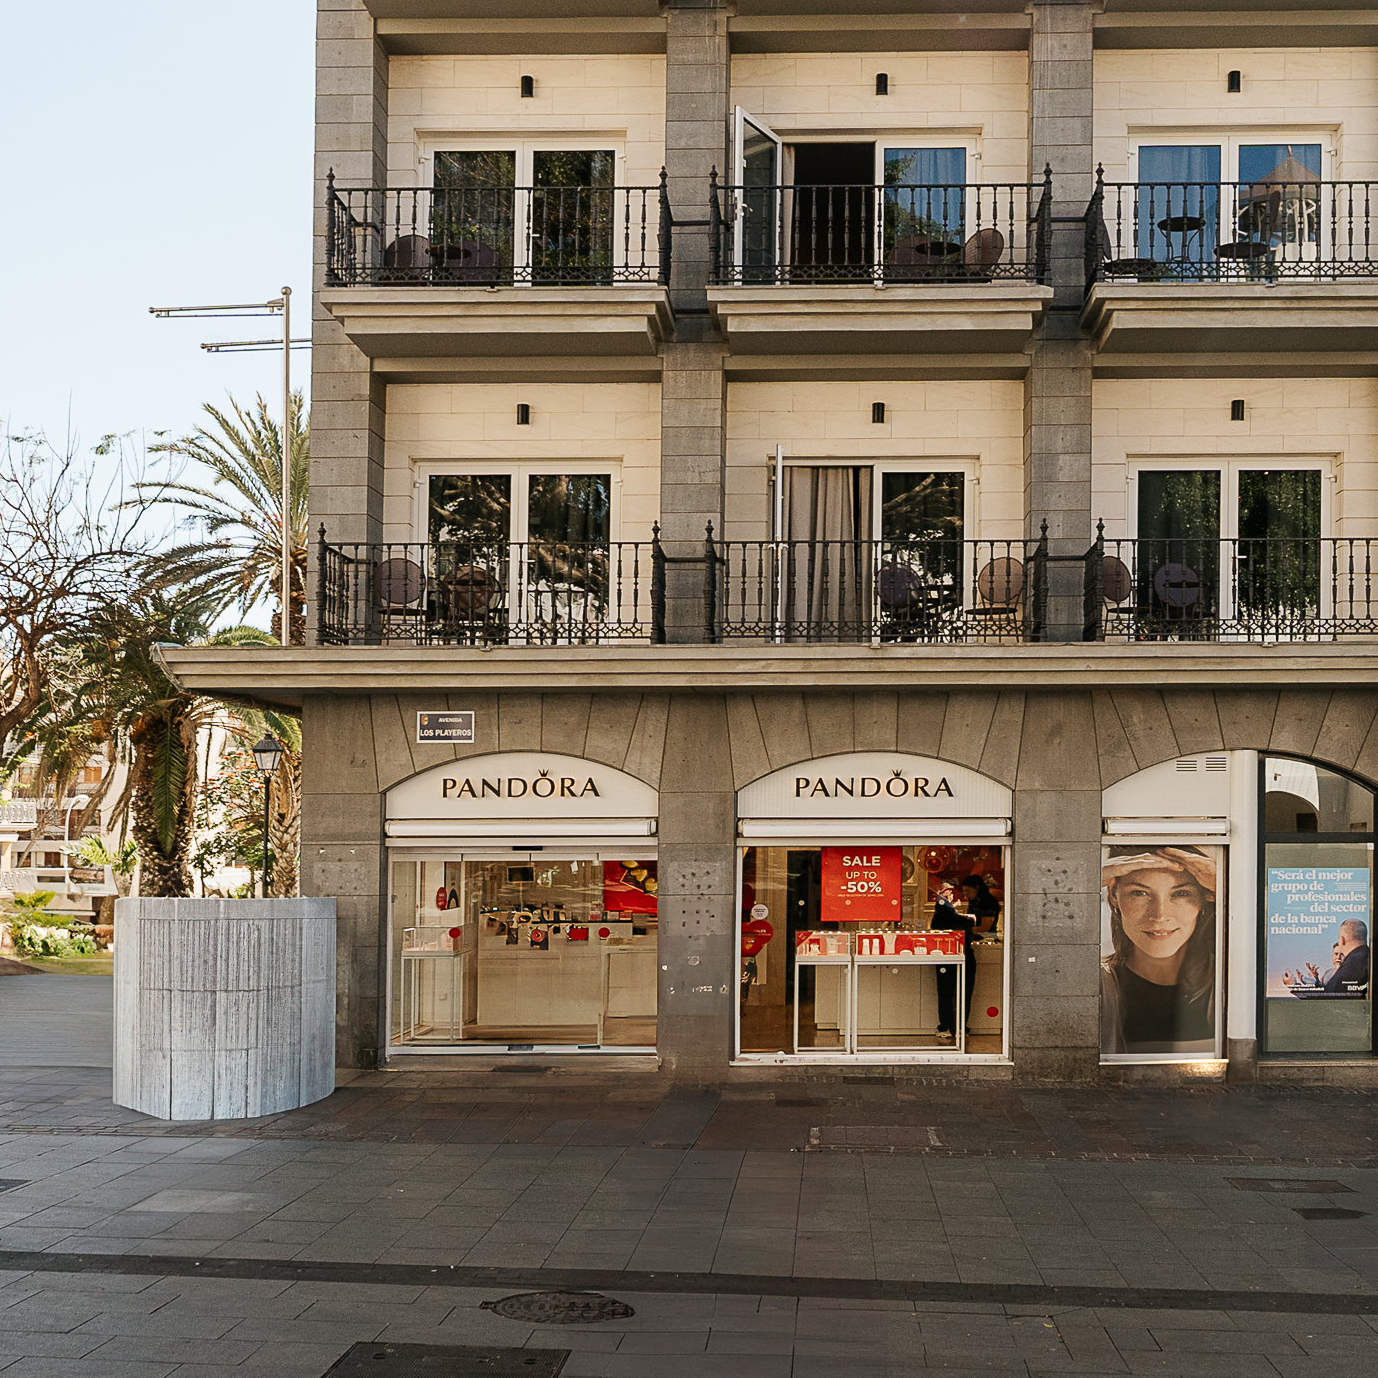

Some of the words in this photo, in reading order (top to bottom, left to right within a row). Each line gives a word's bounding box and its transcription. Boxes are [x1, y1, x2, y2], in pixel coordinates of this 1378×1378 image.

[442, 775, 601, 799] PANDORA
[795, 775, 954, 798] PANDORA
[842, 855, 881, 867] SALE
[845, 871, 860, 879] UP
[862, 871, 877, 879] TO
[1305, 870, 1316, 880] el
[1318, 870, 1353, 881] mejor
[840, 881, 882, 893] -50%
[1270, 883, 1308, 893] grupo
[1309, 881, 1324, 891] de
[1287, 891, 1367, 904] profesionales
[1310, 902, 1329, 912] del
[1330, 903, 1367, 912] sector
[1270, 913, 1286, 923] de
[1287, 913, 1298, 923] la
[1300, 913, 1337, 923] banca
